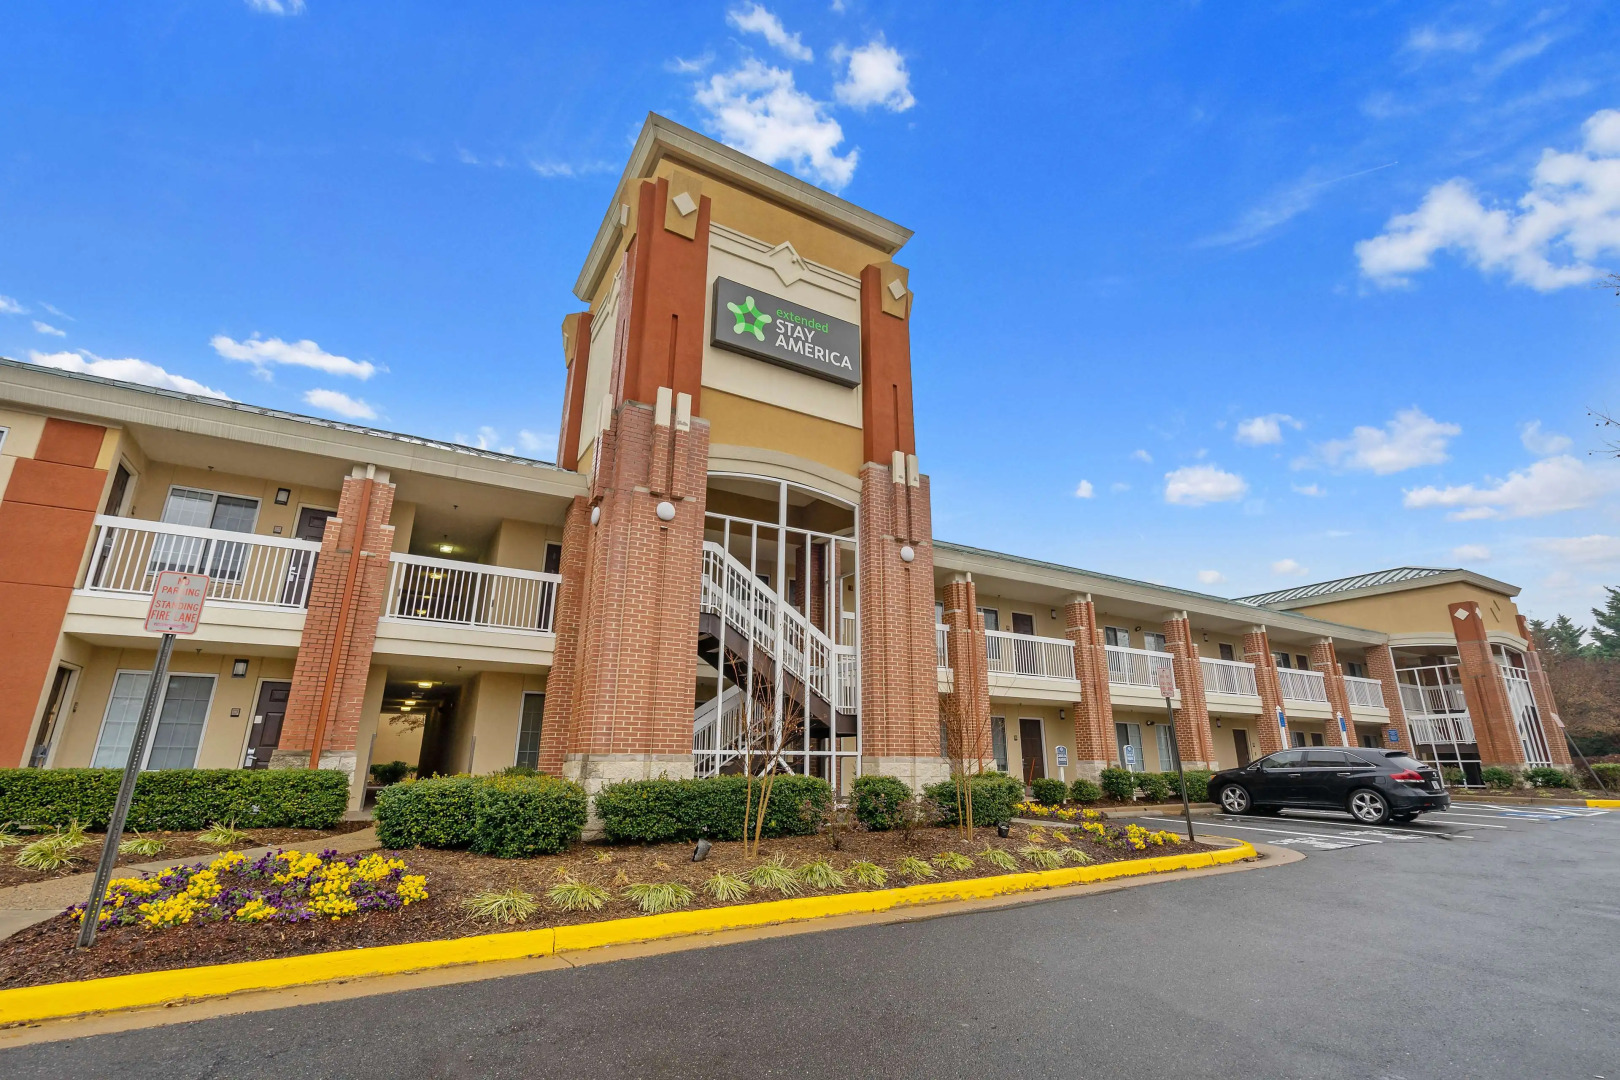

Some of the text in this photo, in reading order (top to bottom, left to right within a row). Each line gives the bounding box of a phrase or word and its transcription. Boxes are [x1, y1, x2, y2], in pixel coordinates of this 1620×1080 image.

[775, 319, 815, 343] STAY
[776, 308, 829, 334] extended
[775, 334, 853, 370] AMERICA
[161, 586, 200, 597] PARING
[150, 609, 171, 621] FIRE
